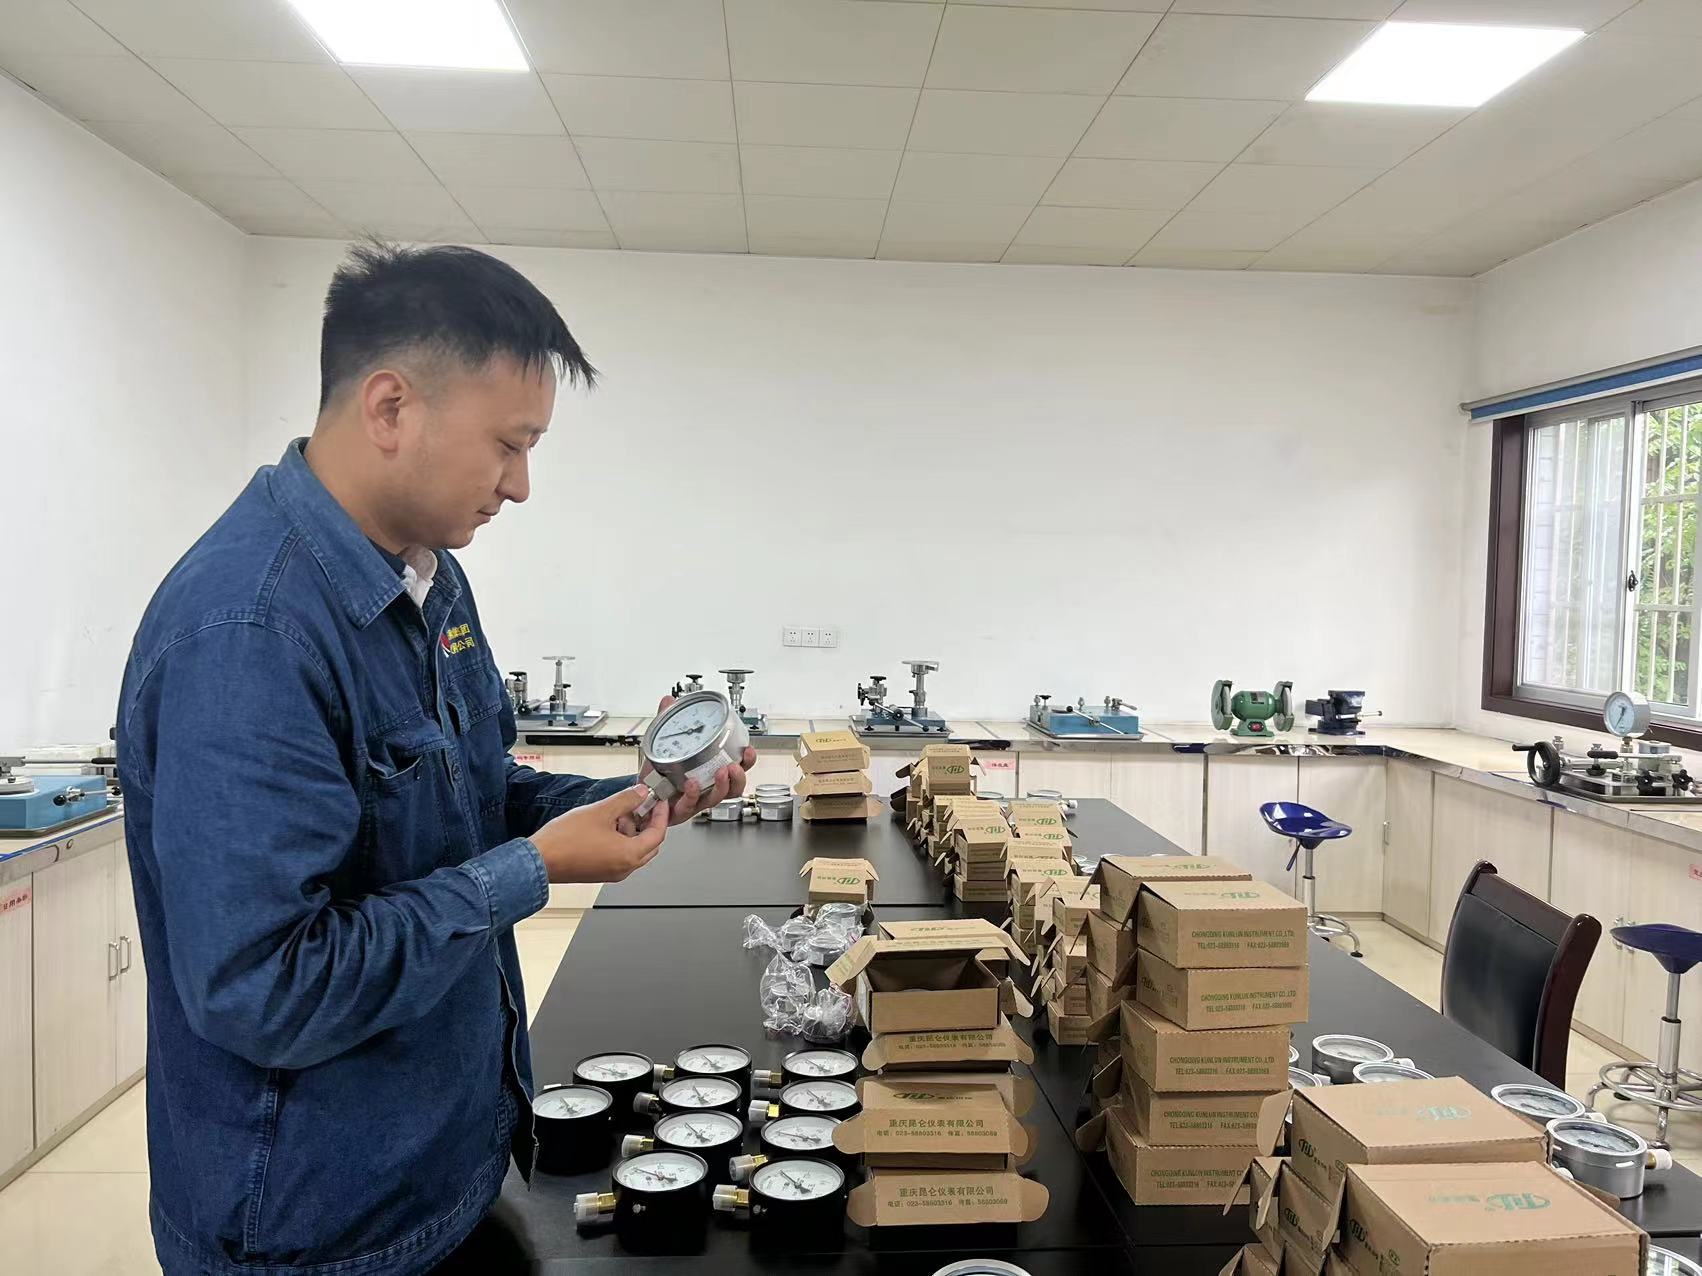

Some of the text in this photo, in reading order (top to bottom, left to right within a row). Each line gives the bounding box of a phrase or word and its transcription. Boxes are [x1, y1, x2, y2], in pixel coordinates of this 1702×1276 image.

[888, 1119, 984, 1128] 重庆昆仑仪表有限公司
[899, 1186, 994, 1198] 重庆昆仑仪表有限公司
